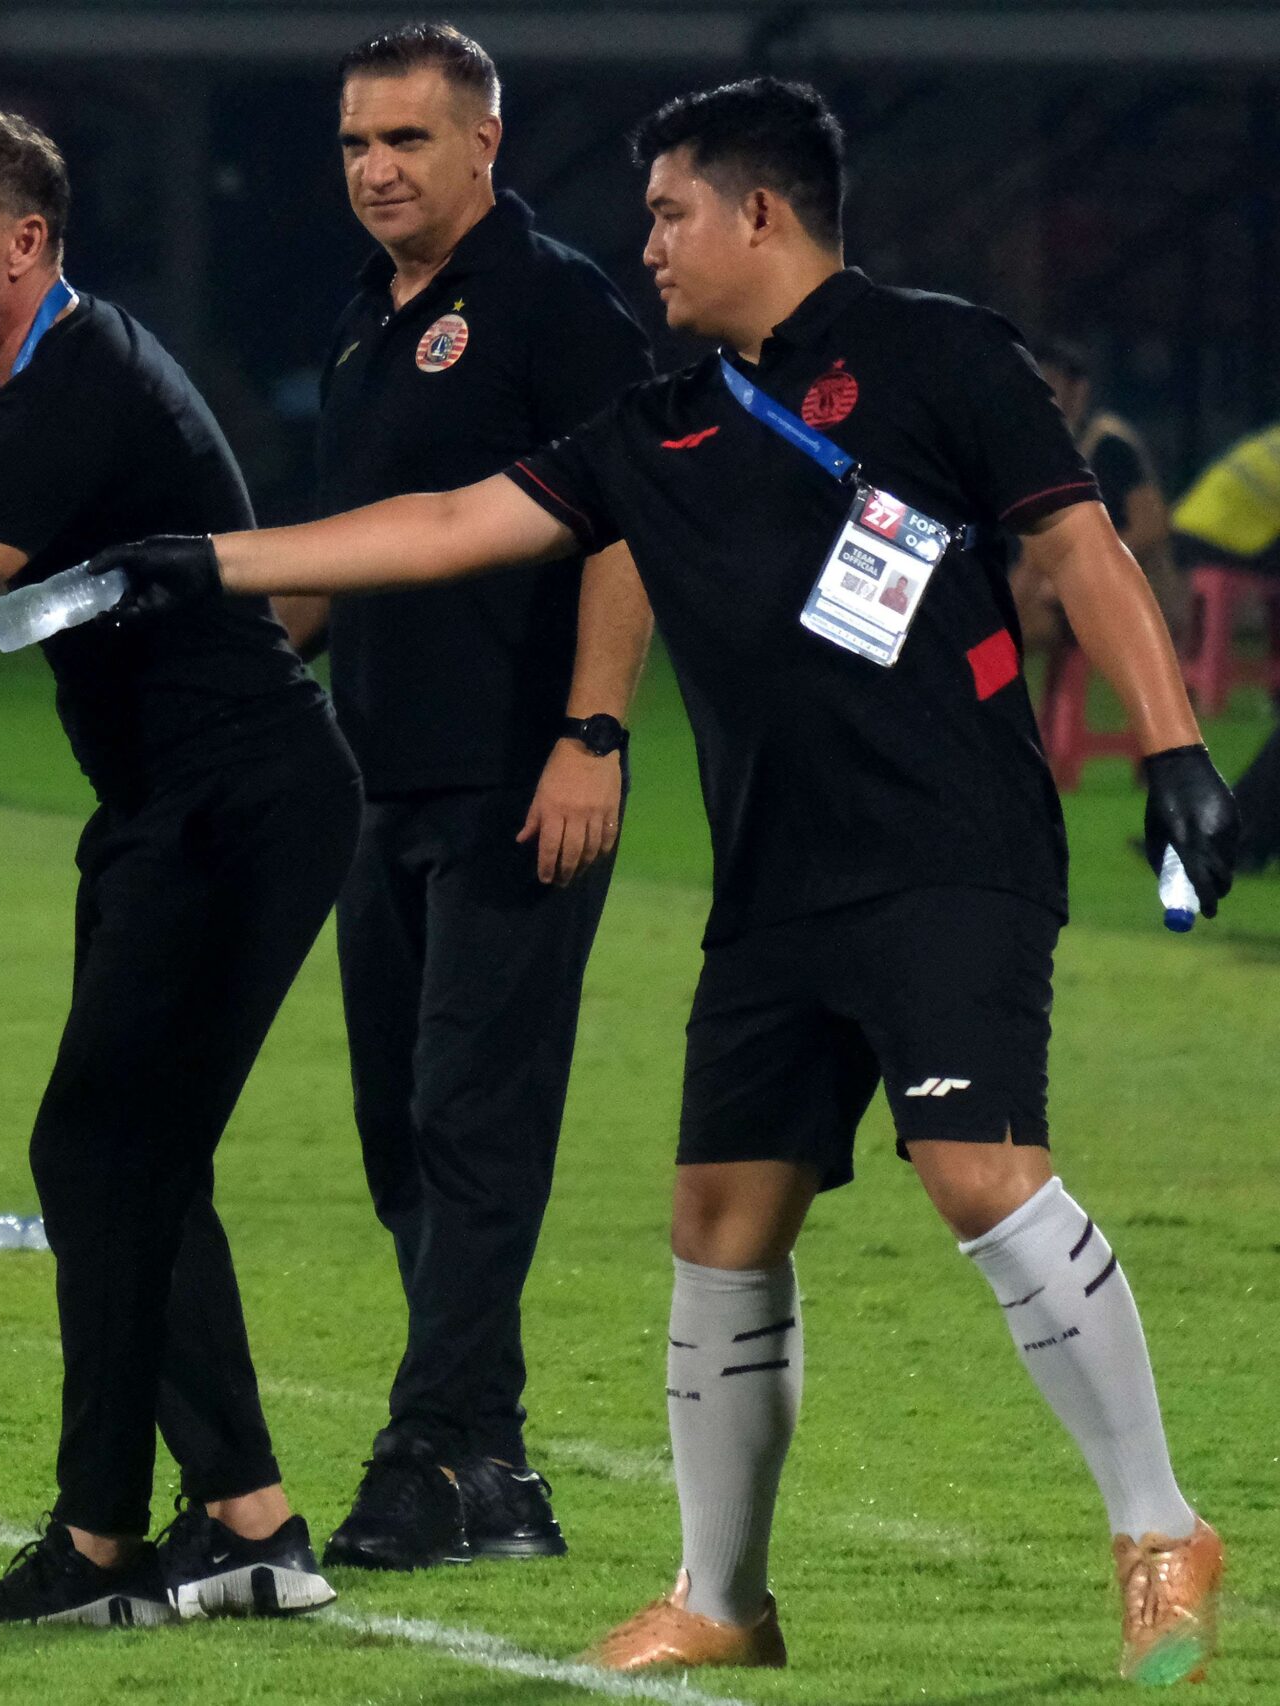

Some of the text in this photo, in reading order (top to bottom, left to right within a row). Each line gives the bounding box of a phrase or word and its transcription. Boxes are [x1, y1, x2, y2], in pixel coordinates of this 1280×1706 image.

[864, 500, 901, 530] 27
[842, 552, 878, 576] OFFICIAL
[852, 548, 876, 565] TEAM
